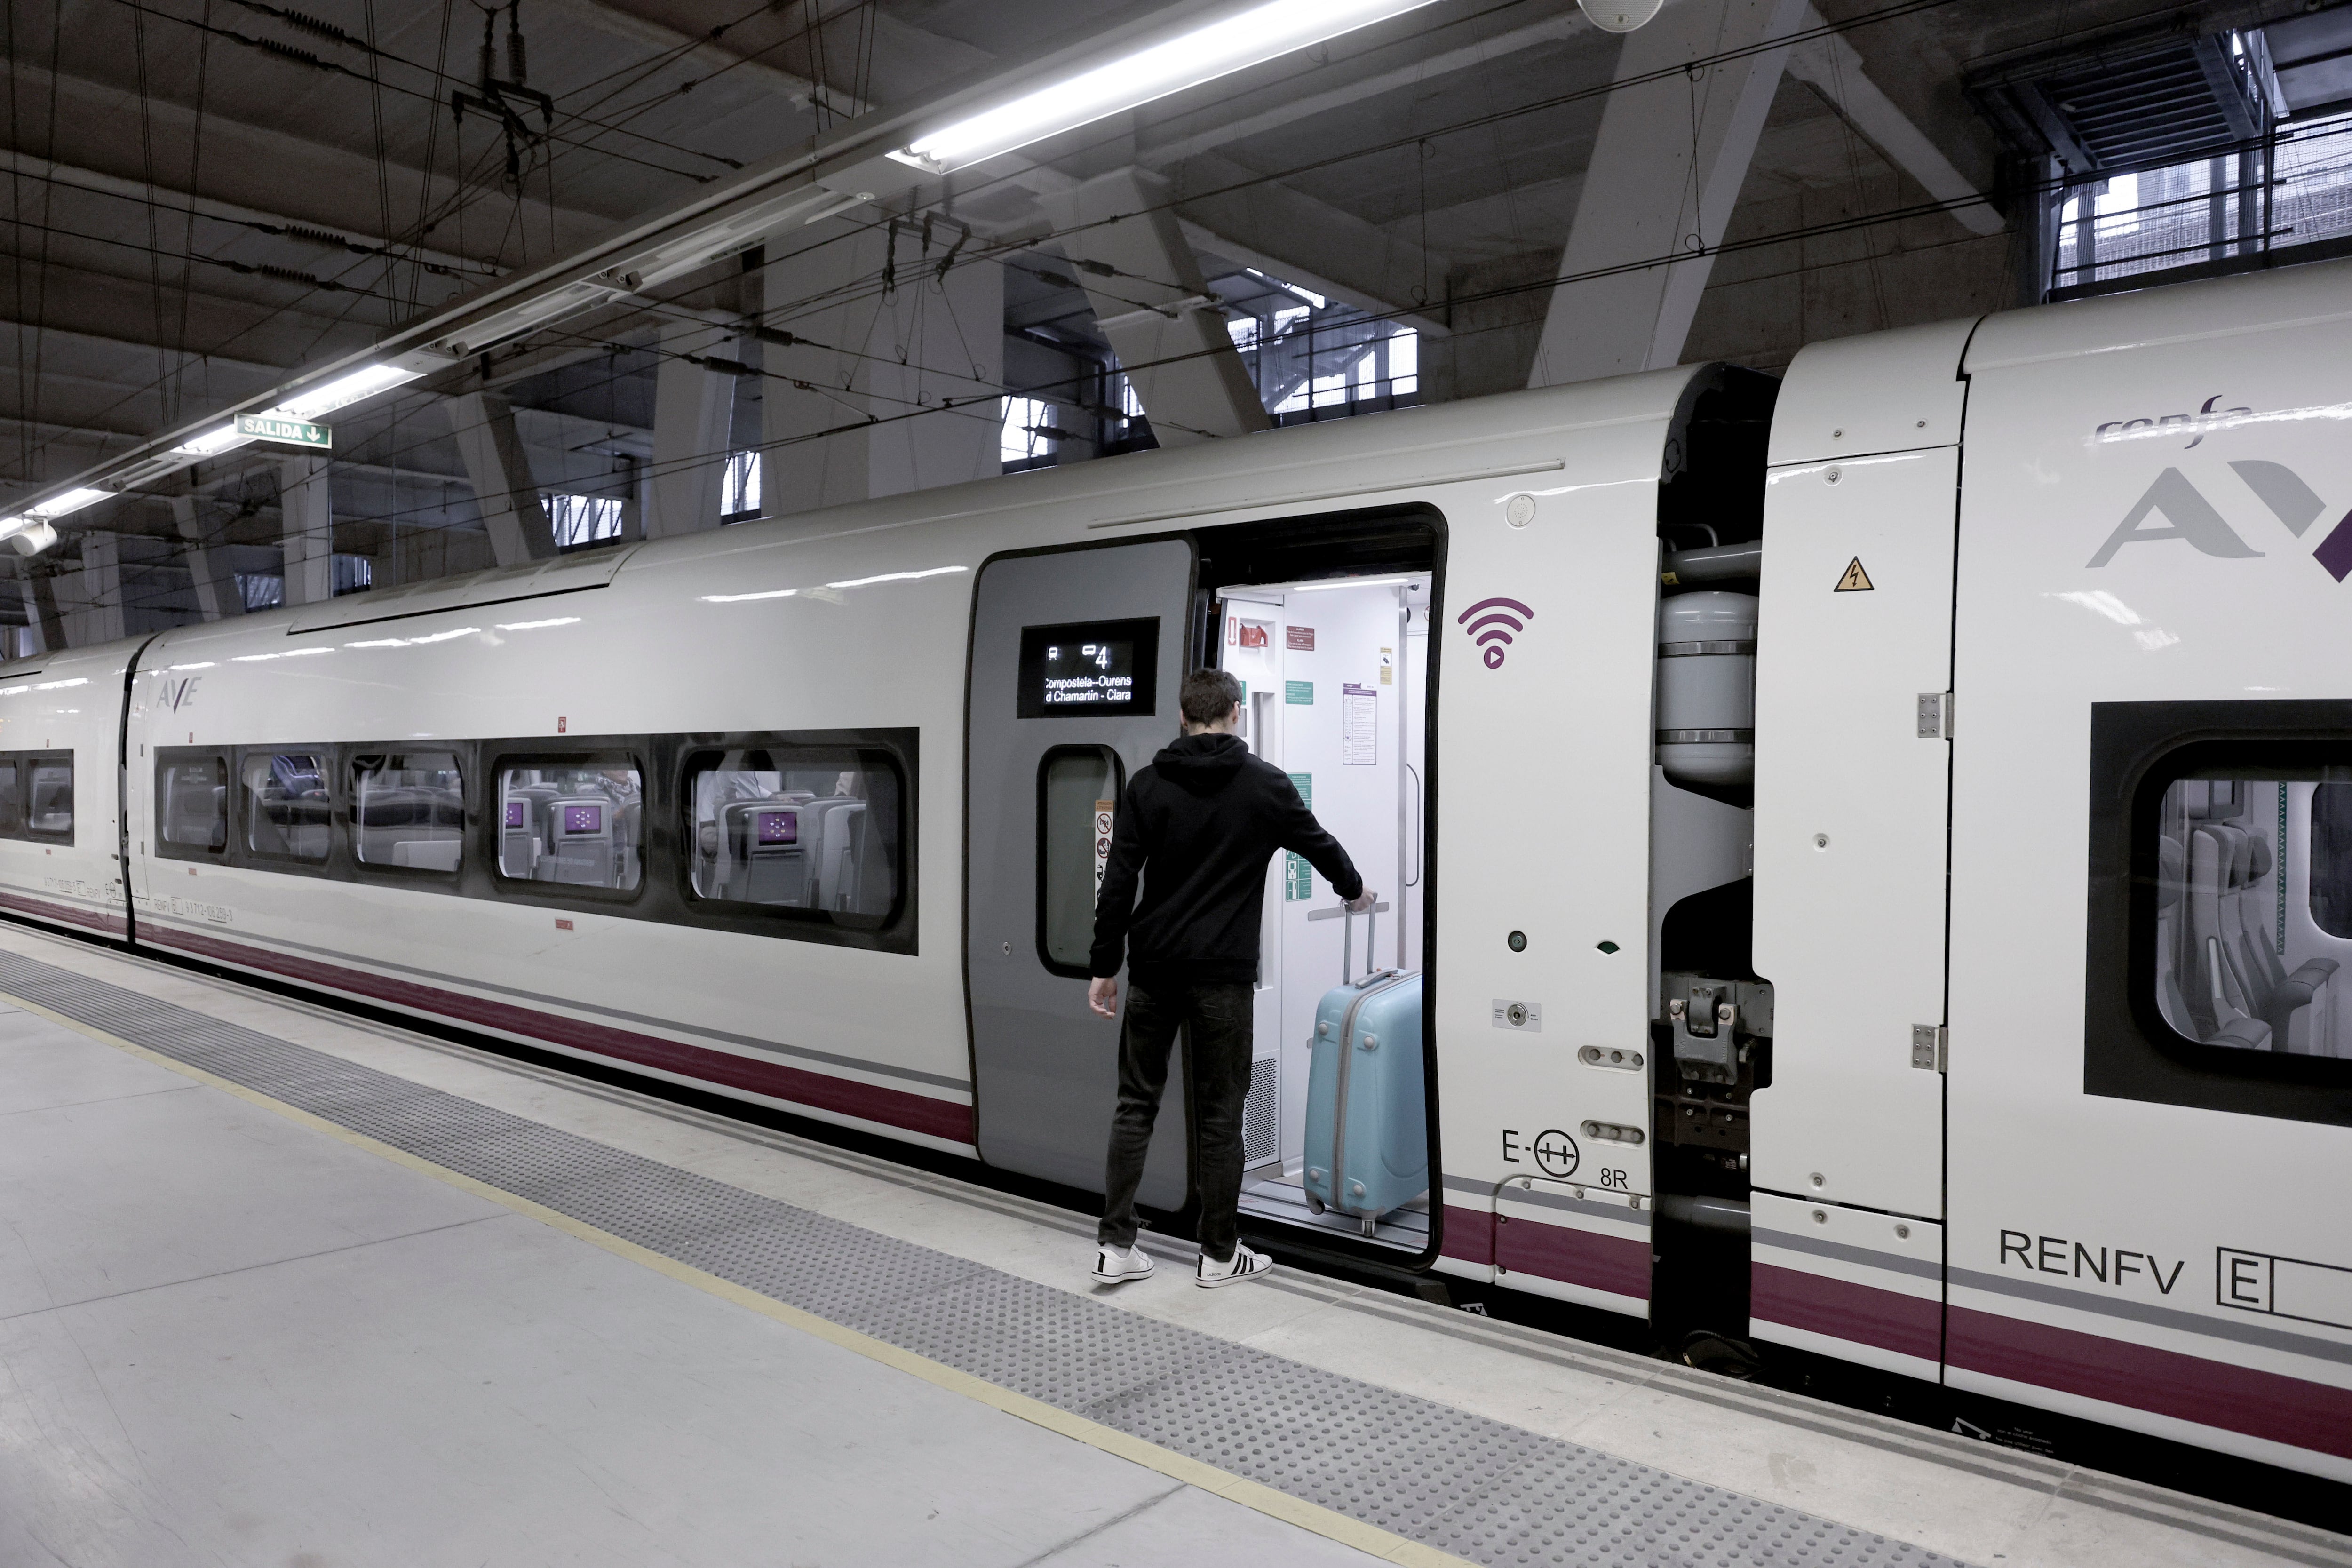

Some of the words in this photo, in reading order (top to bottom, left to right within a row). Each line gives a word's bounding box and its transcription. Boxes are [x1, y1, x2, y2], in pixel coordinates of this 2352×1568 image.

[244, 419, 303, 439] SALIDA
[1096, 646, 1107, 669] 4
[156, 677, 202, 714] AVE
[1107, 689, 1131, 700] Clara
[1601, 1168, 1628, 1189] 8R
[2001, 1229, 2185, 1294] RENFV
[2232, 1258, 2259, 1303] E
